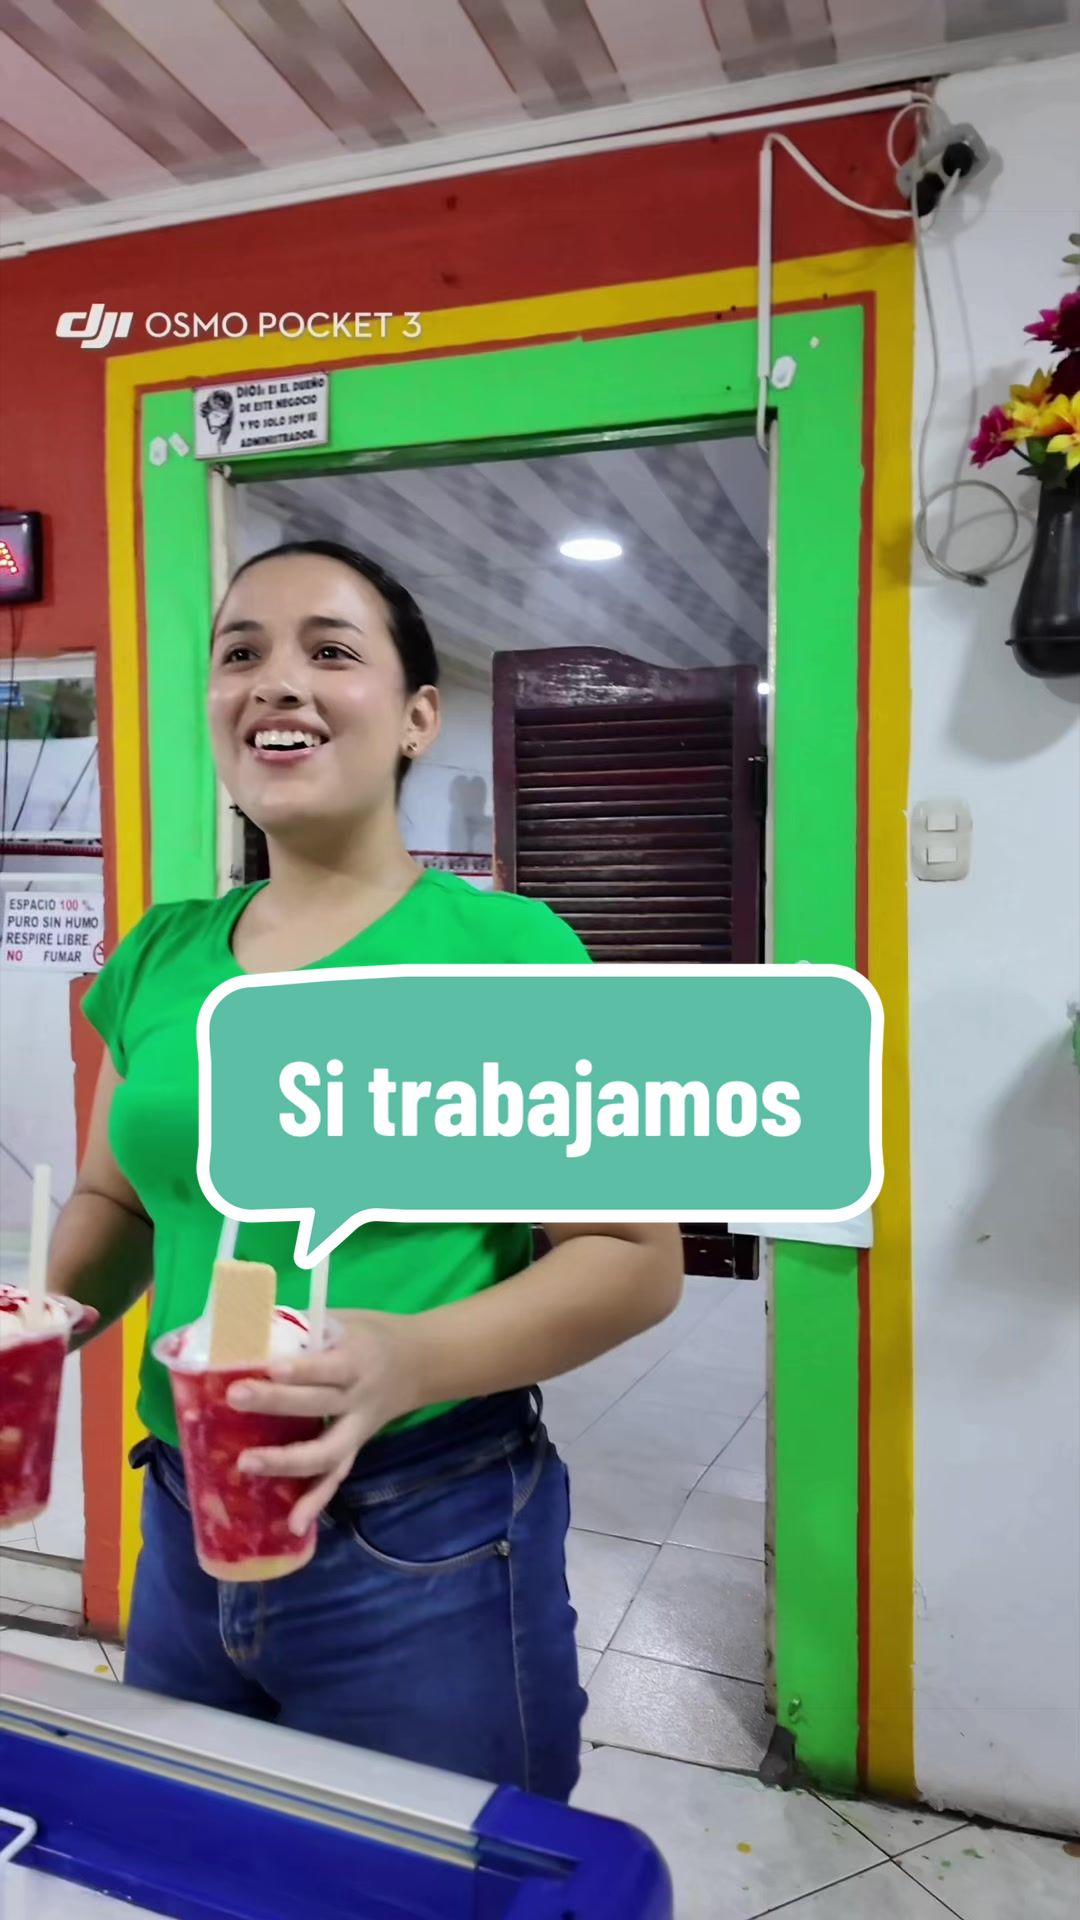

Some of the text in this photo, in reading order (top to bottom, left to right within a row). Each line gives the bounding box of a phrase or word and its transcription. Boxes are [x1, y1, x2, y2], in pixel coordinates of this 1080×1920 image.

[280, 383, 290, 393] EL
[293, 377, 325, 391] DUEÑO
[240, 394, 318, 413] DE ESTE NEGOCIO
[240, 421, 245, 430] Y
[248, 419, 260, 429] YO
[263, 415, 286, 428] SOLO
[288, 413, 305, 425] SOY
[9, 899, 56, 910] ESPACIO
[7, 915, 99, 929] PURO SIN HUMO
[6, 932, 53, 945] RESPIRE
[7, 950, 82, 962] NO FUMAR
